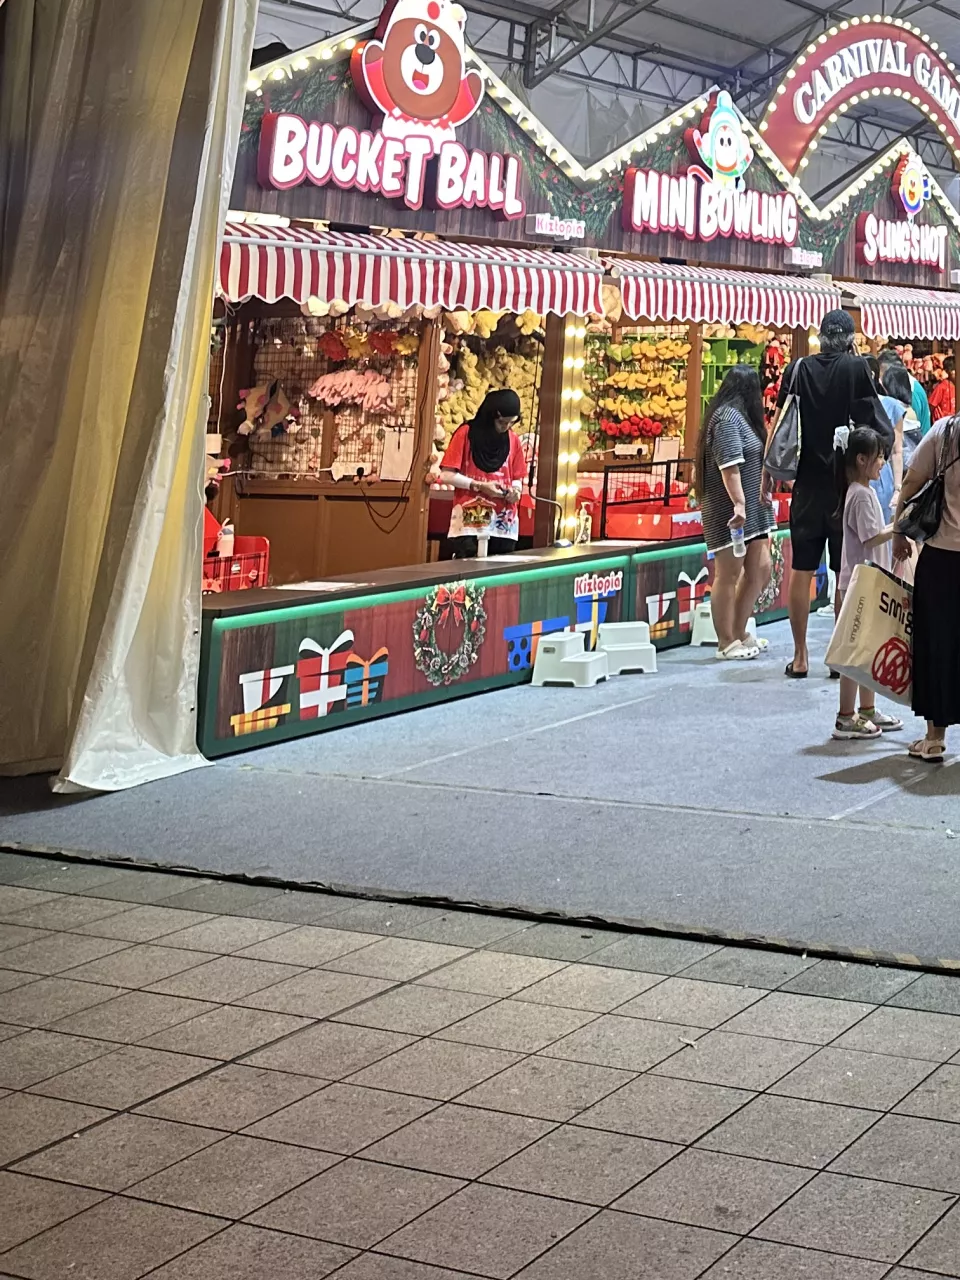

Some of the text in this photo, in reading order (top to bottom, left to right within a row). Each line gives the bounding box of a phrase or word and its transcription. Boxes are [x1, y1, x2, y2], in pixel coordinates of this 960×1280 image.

[793, 38, 911, 124] CARNIVAL
[270, 114, 526, 219] BUCKET BALL
[536, 214, 585, 240] Kiztopia
[632, 169, 798, 246] MINI BOWLING
[574, 571, 623, 597] Kiztopia
